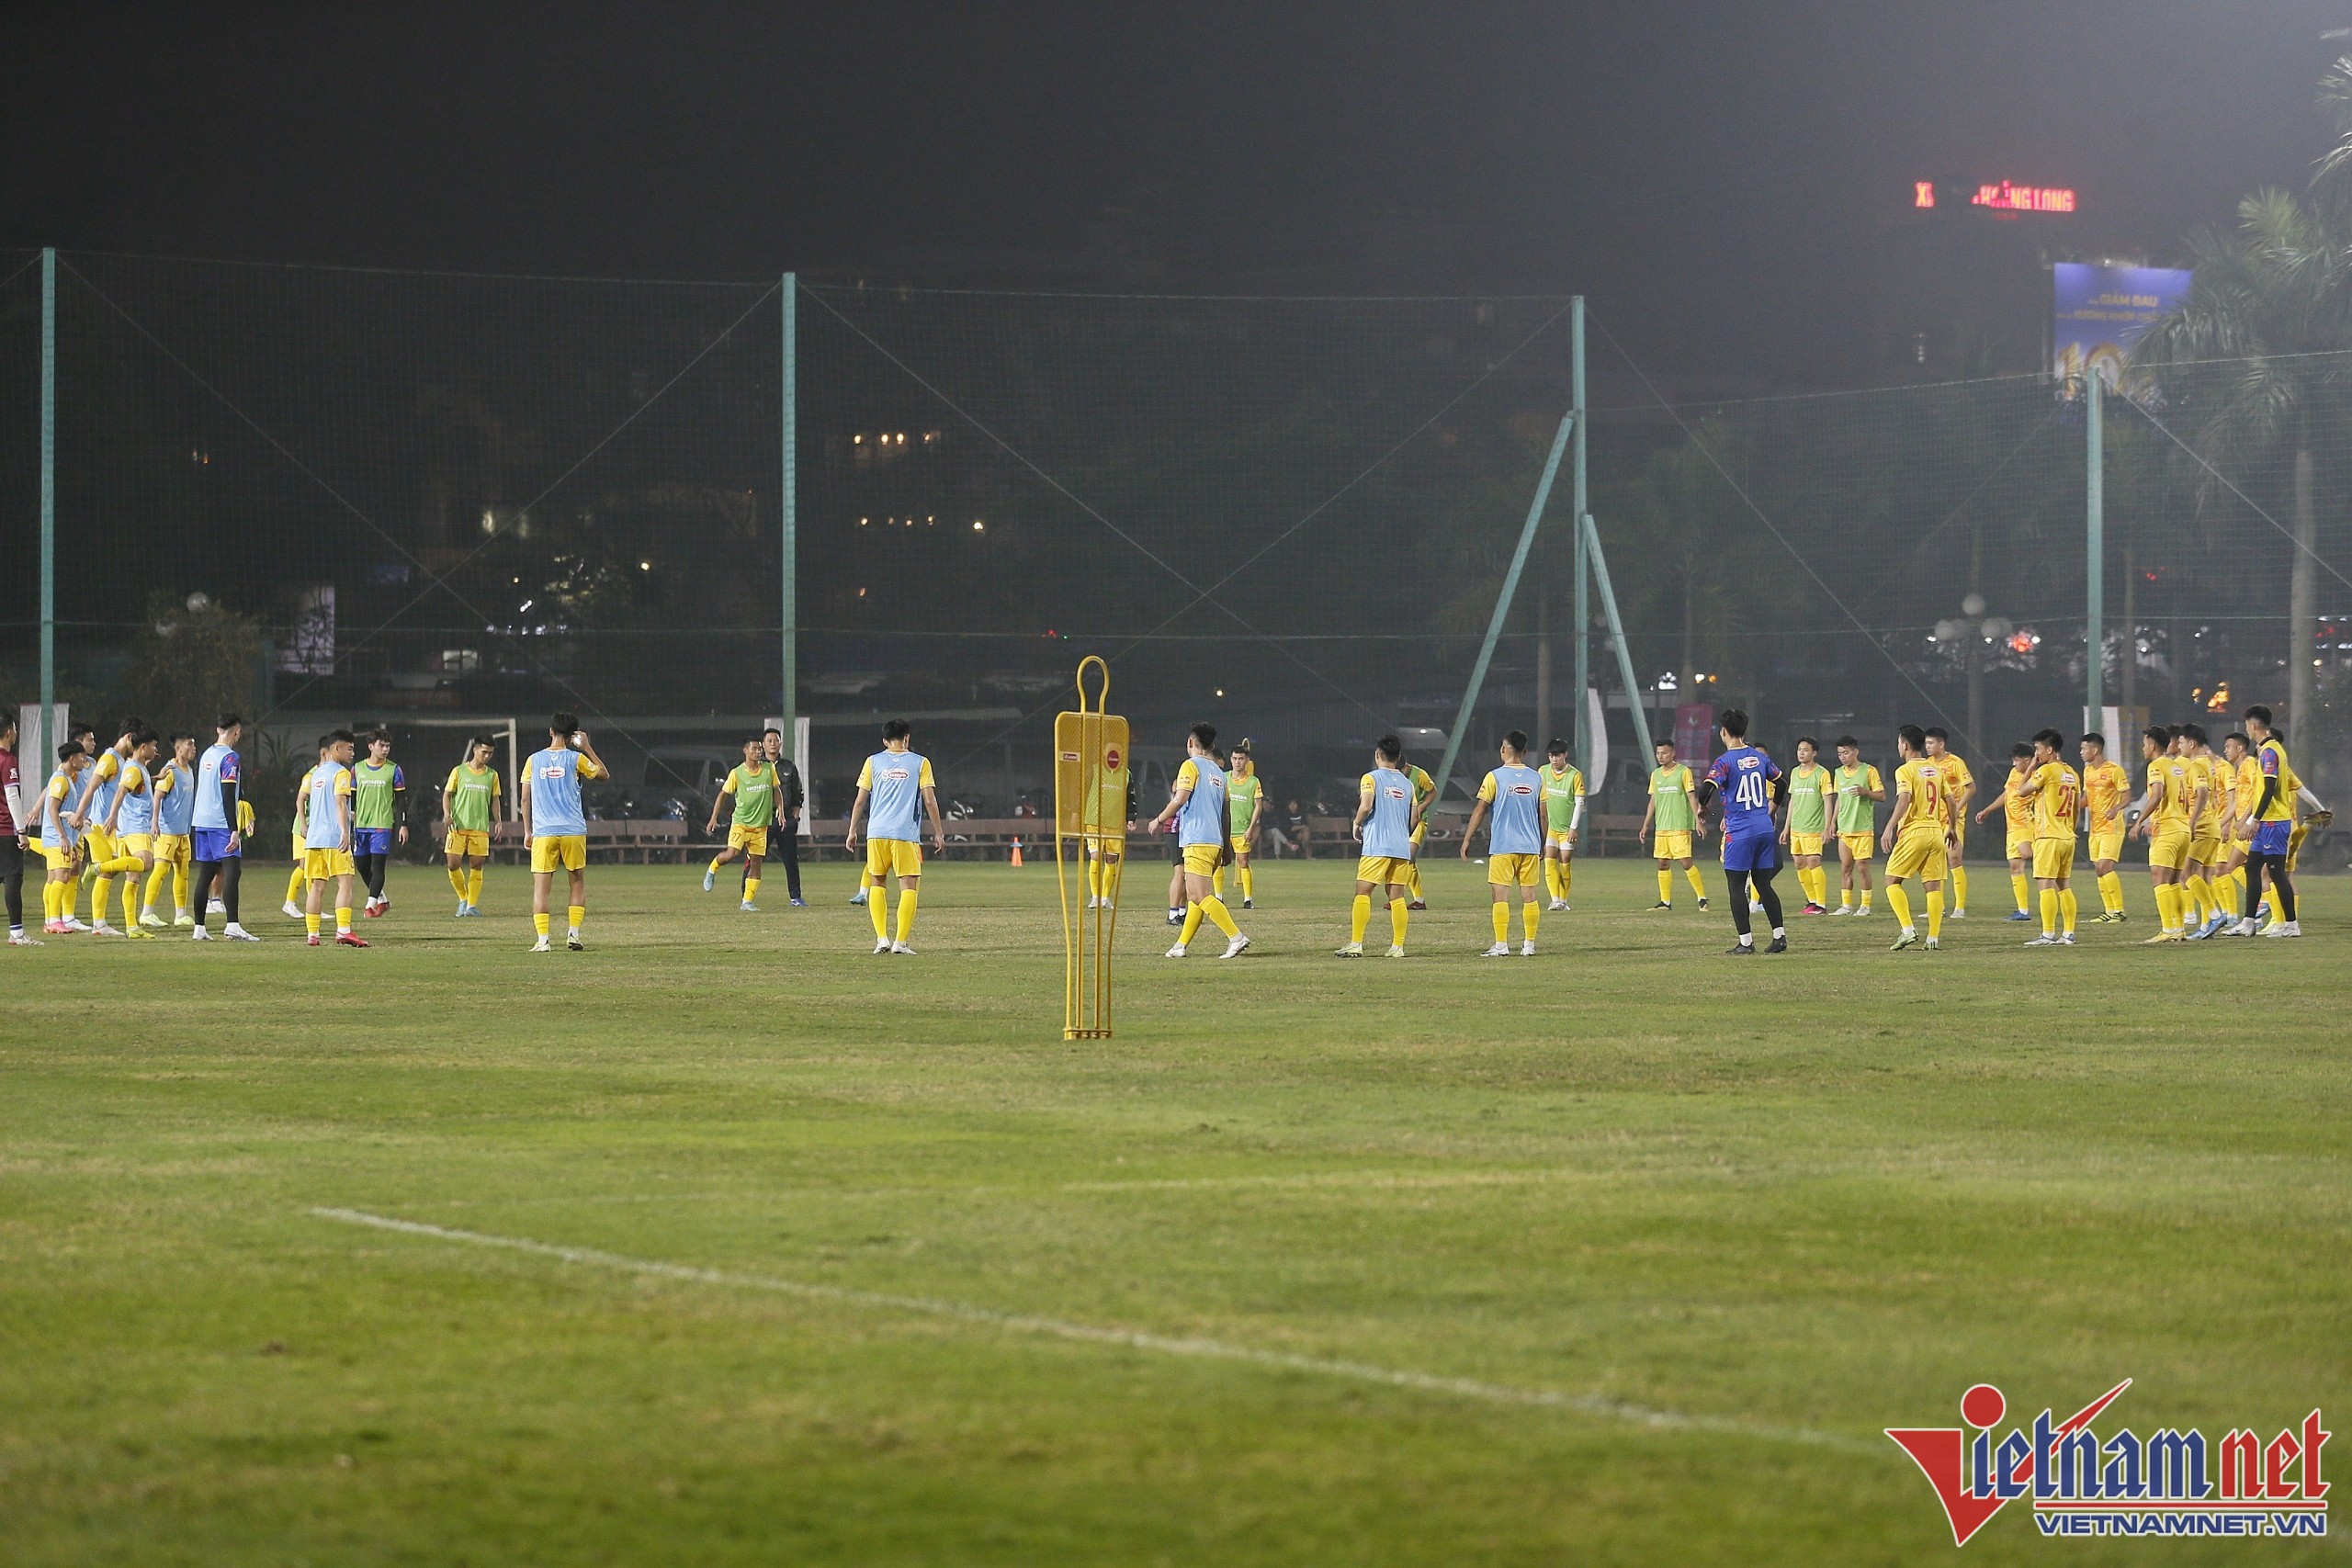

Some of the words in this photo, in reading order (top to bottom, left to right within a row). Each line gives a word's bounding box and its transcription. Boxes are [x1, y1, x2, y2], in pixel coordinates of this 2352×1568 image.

[2032, 188, 2075, 211] LONG
[1736, 772, 1763, 810] 40
[1926, 781, 1937, 815] 9
[166, 843, 172, 854] 7
[732, 833, 741, 842] 27
